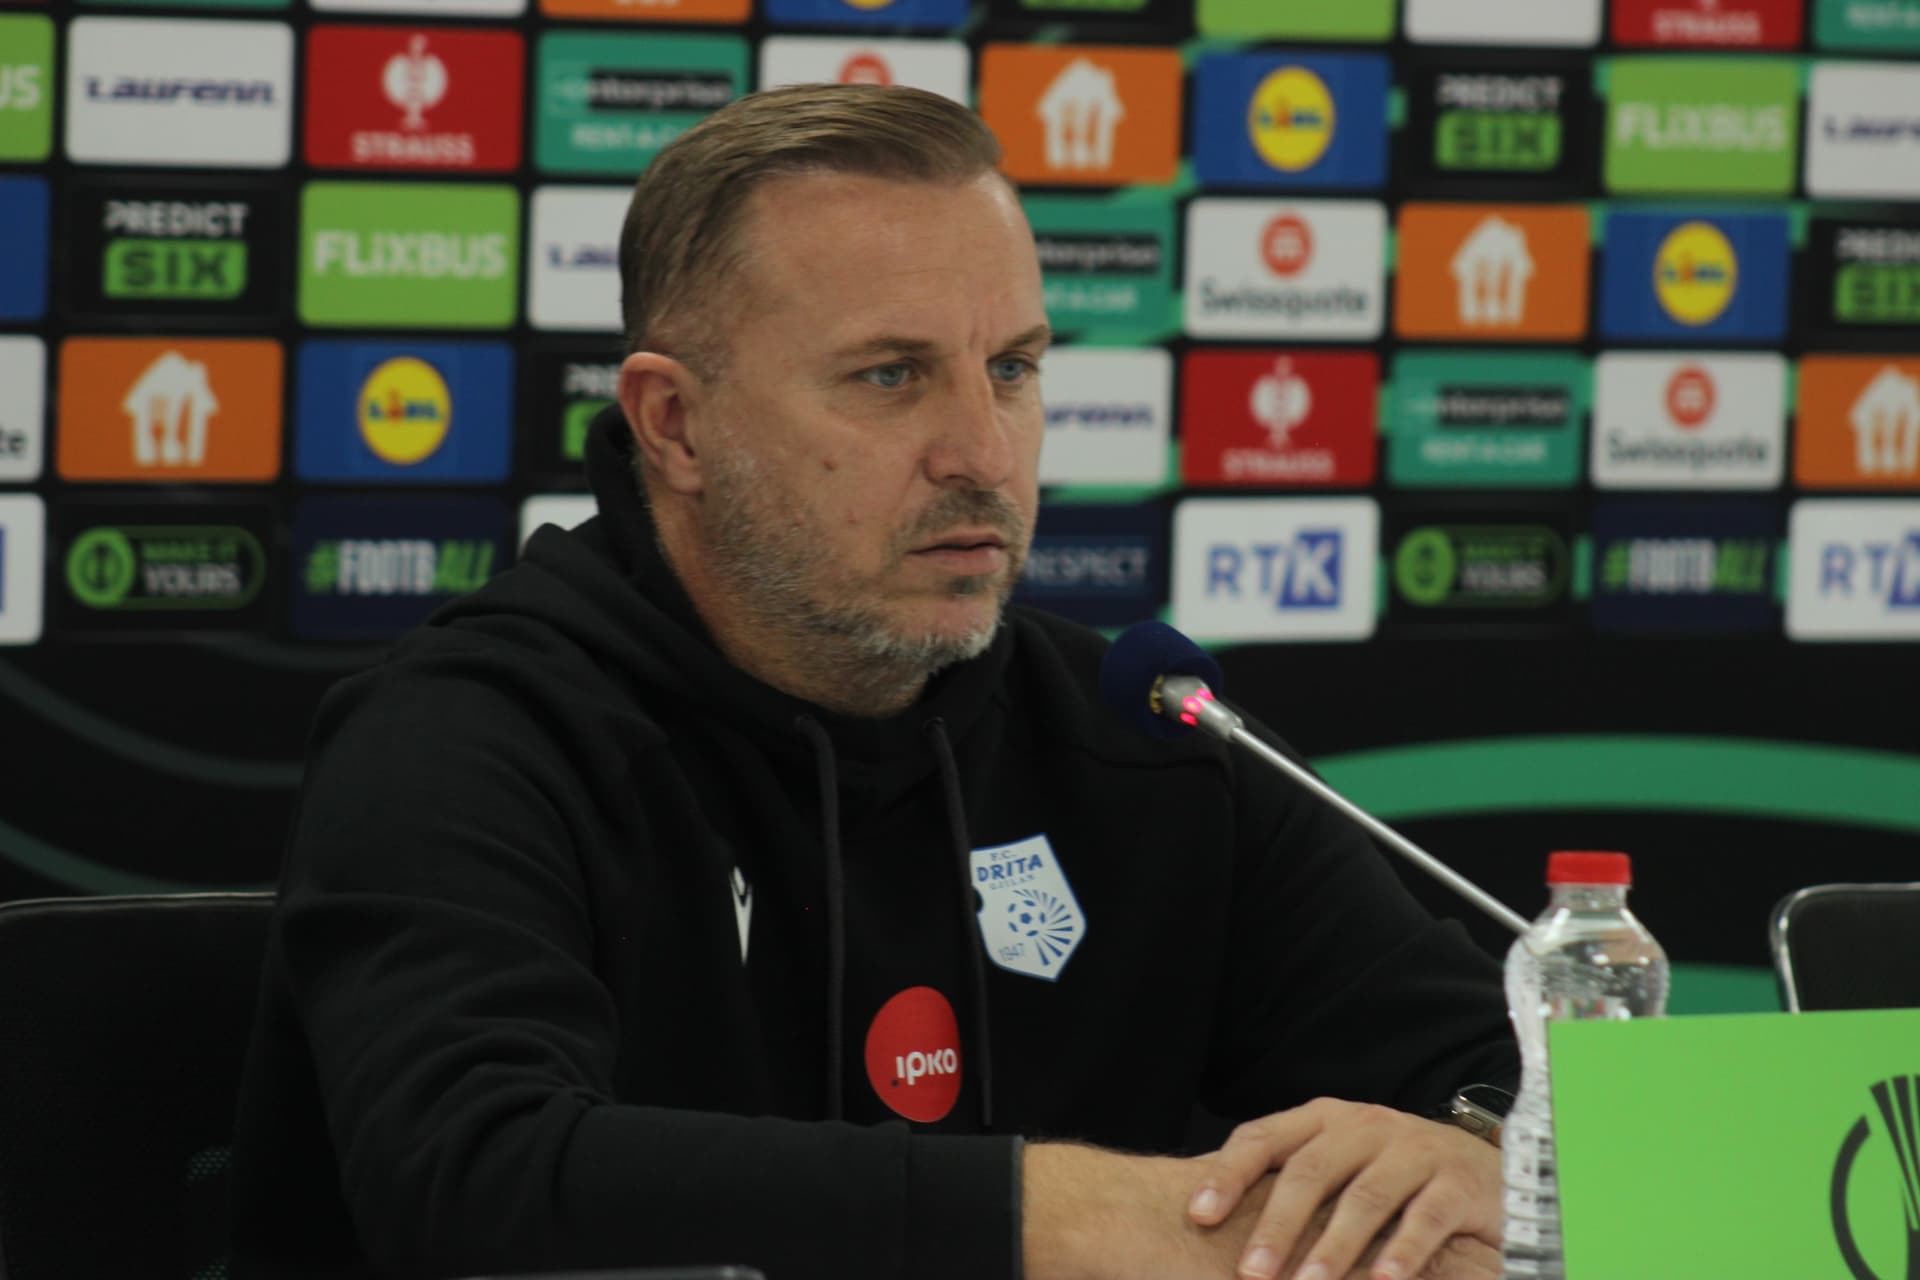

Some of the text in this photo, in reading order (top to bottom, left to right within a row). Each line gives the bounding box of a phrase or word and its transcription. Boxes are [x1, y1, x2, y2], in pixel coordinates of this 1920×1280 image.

[1437, 75, 1562, 109] PREDICT
[352, 131, 474, 164] STRAUSS
[1450, 116, 1546, 163] SIX
[104, 201, 248, 236] PREDICT
[120, 249, 230, 290] SIX
[144, 562, 241, 597] YOURS
[1207, 537, 1341, 601] RTK
[976, 854, 1044, 882] DRITA
